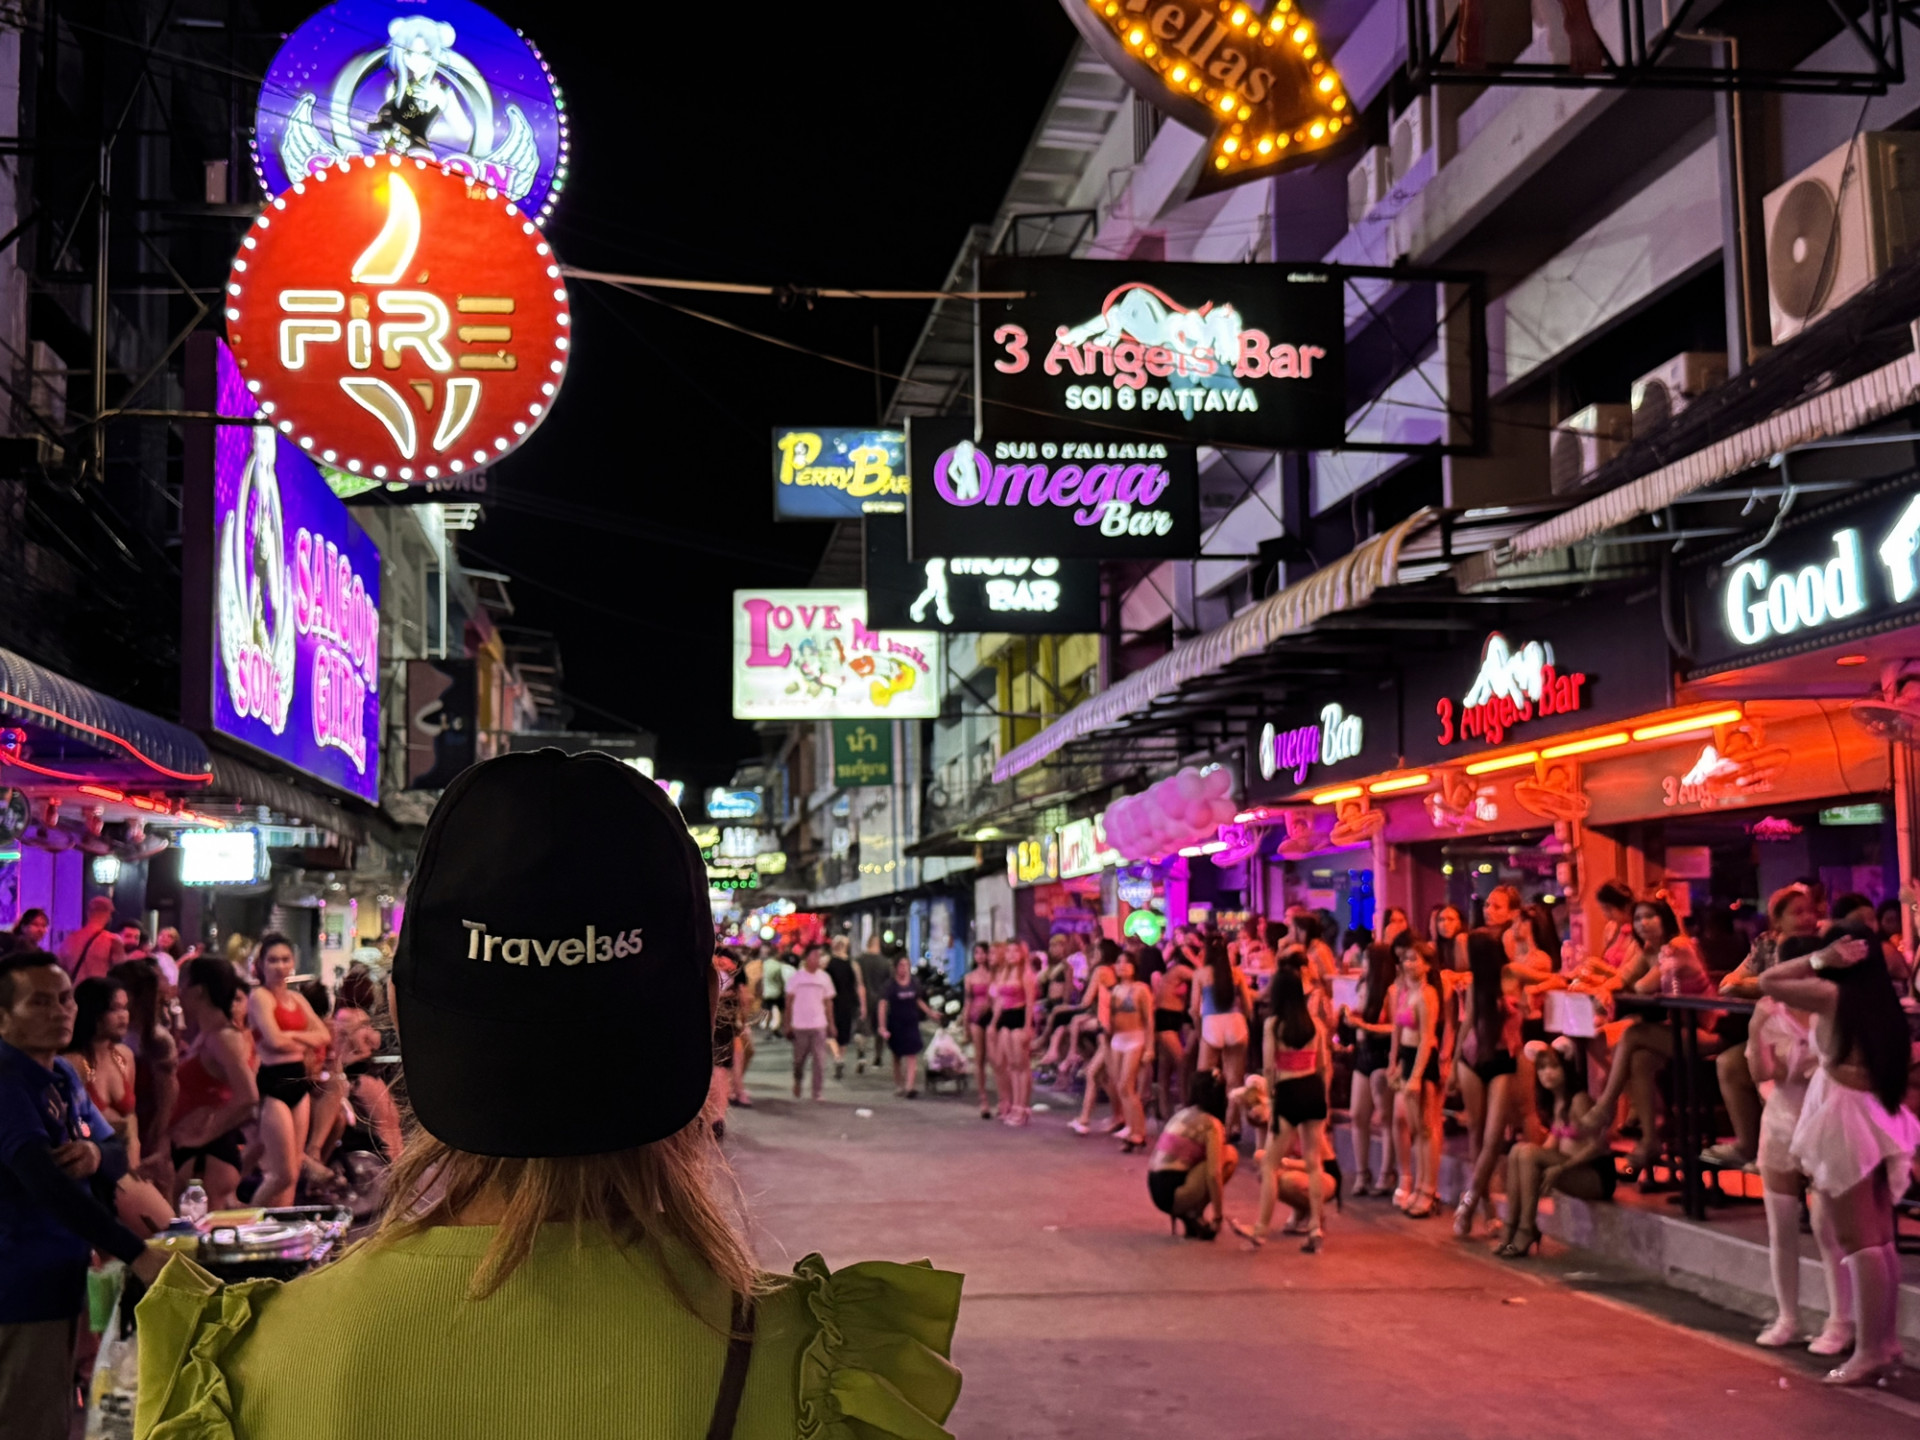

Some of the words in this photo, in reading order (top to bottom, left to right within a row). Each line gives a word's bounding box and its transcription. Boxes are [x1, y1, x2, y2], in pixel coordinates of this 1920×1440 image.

[993, 324, 1030, 374] 3
[1044, 325, 1219, 391] Angels
[1233, 328, 1327, 379] Bar
[1065, 385, 1112, 411] SOI
[1117, 386, 1137, 411] 6
[1141, 387, 1259, 412] PATTAYA
[934, 446, 1170, 526] Omega
[1100, 500, 1174, 537] Bar
[985, 579, 1060, 612] BAR
[1726, 528, 1867, 645] Good
[743, 598, 842, 668] LOVE
[311, 645, 366, 775] GIRL
[1321, 703, 1363, 766] Bar
[1436, 697, 1454, 745] 3
[1539, 664, 1586, 717] Bar
[462, 918, 643, 967] Travel365
